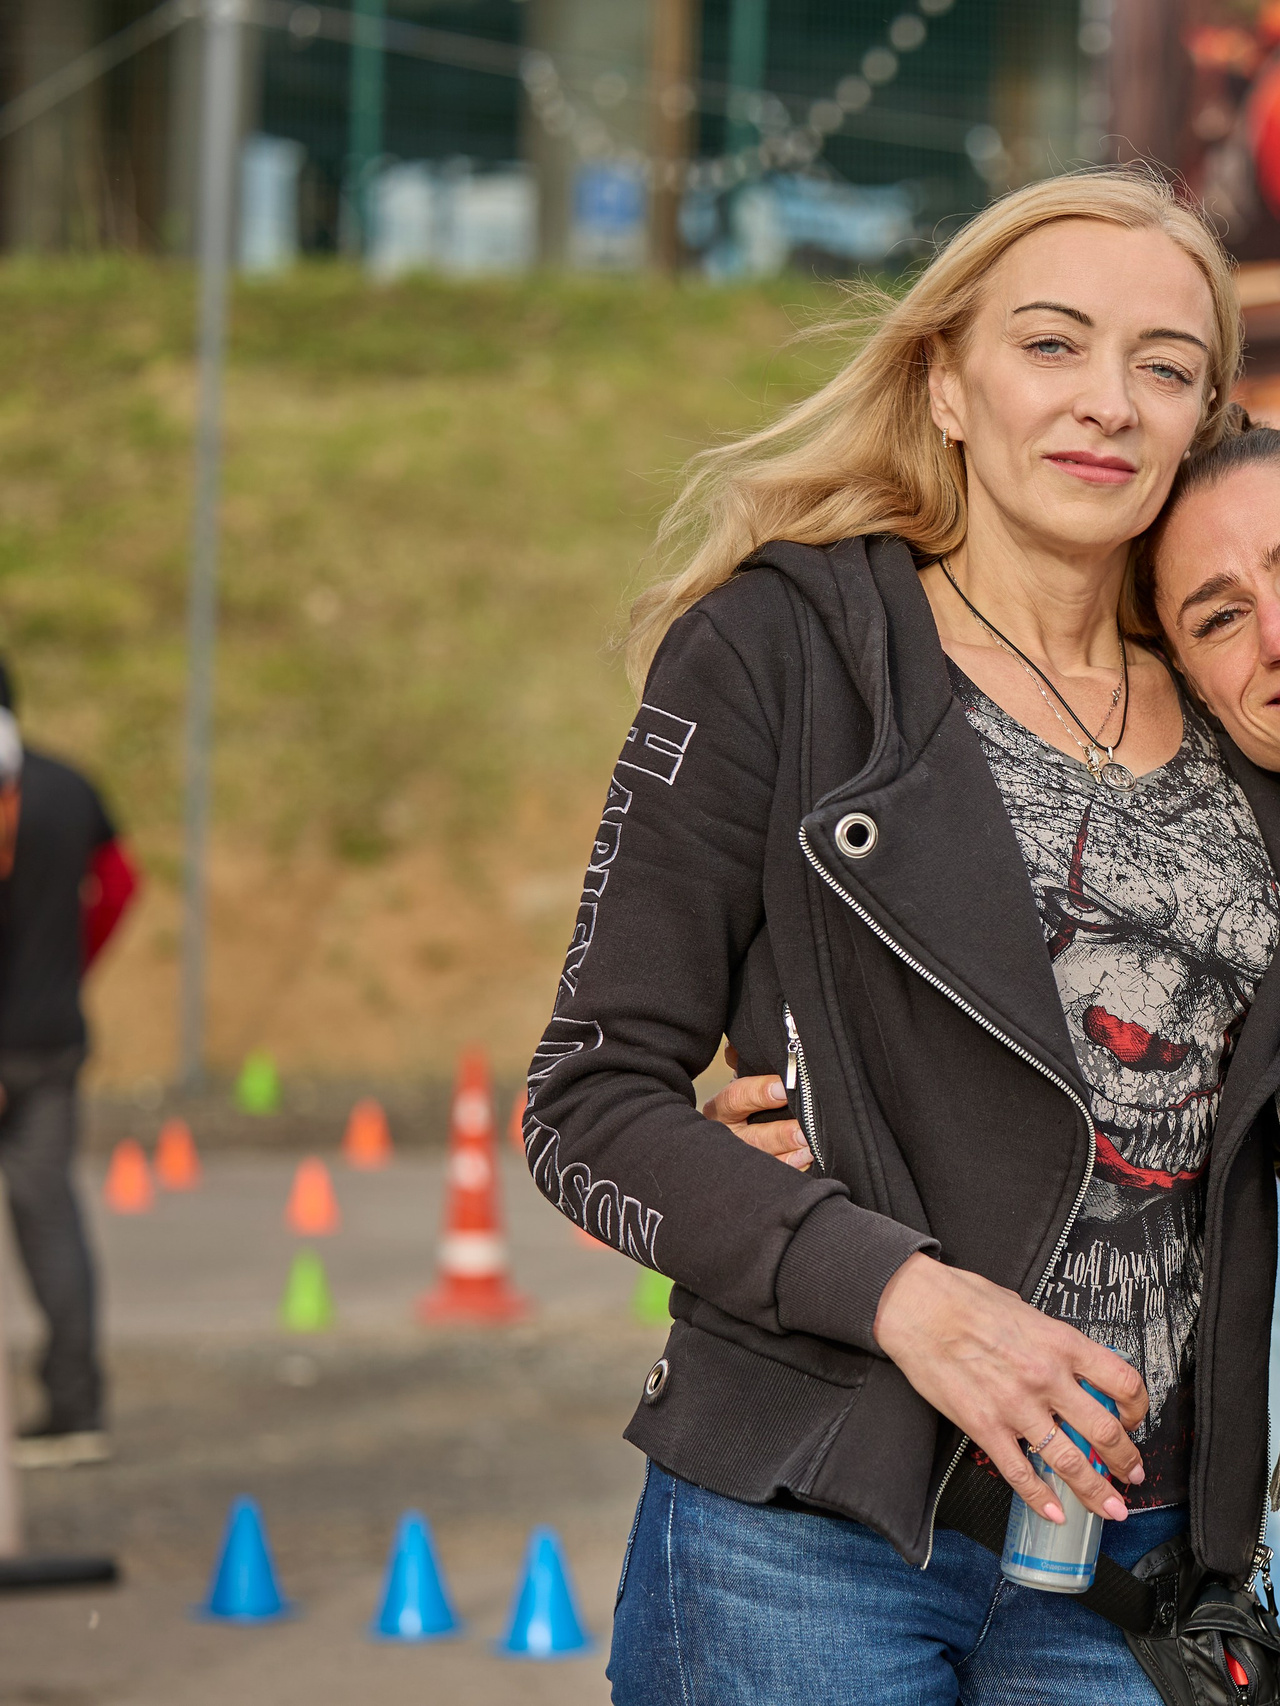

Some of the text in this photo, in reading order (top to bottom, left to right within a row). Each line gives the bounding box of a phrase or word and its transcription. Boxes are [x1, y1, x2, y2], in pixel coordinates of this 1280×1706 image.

[1106, 1247, 1159, 1290] DOWN
[1088, 1276, 1134, 1324] FLOAT
[1141, 1276, 1165, 1322] TOO
